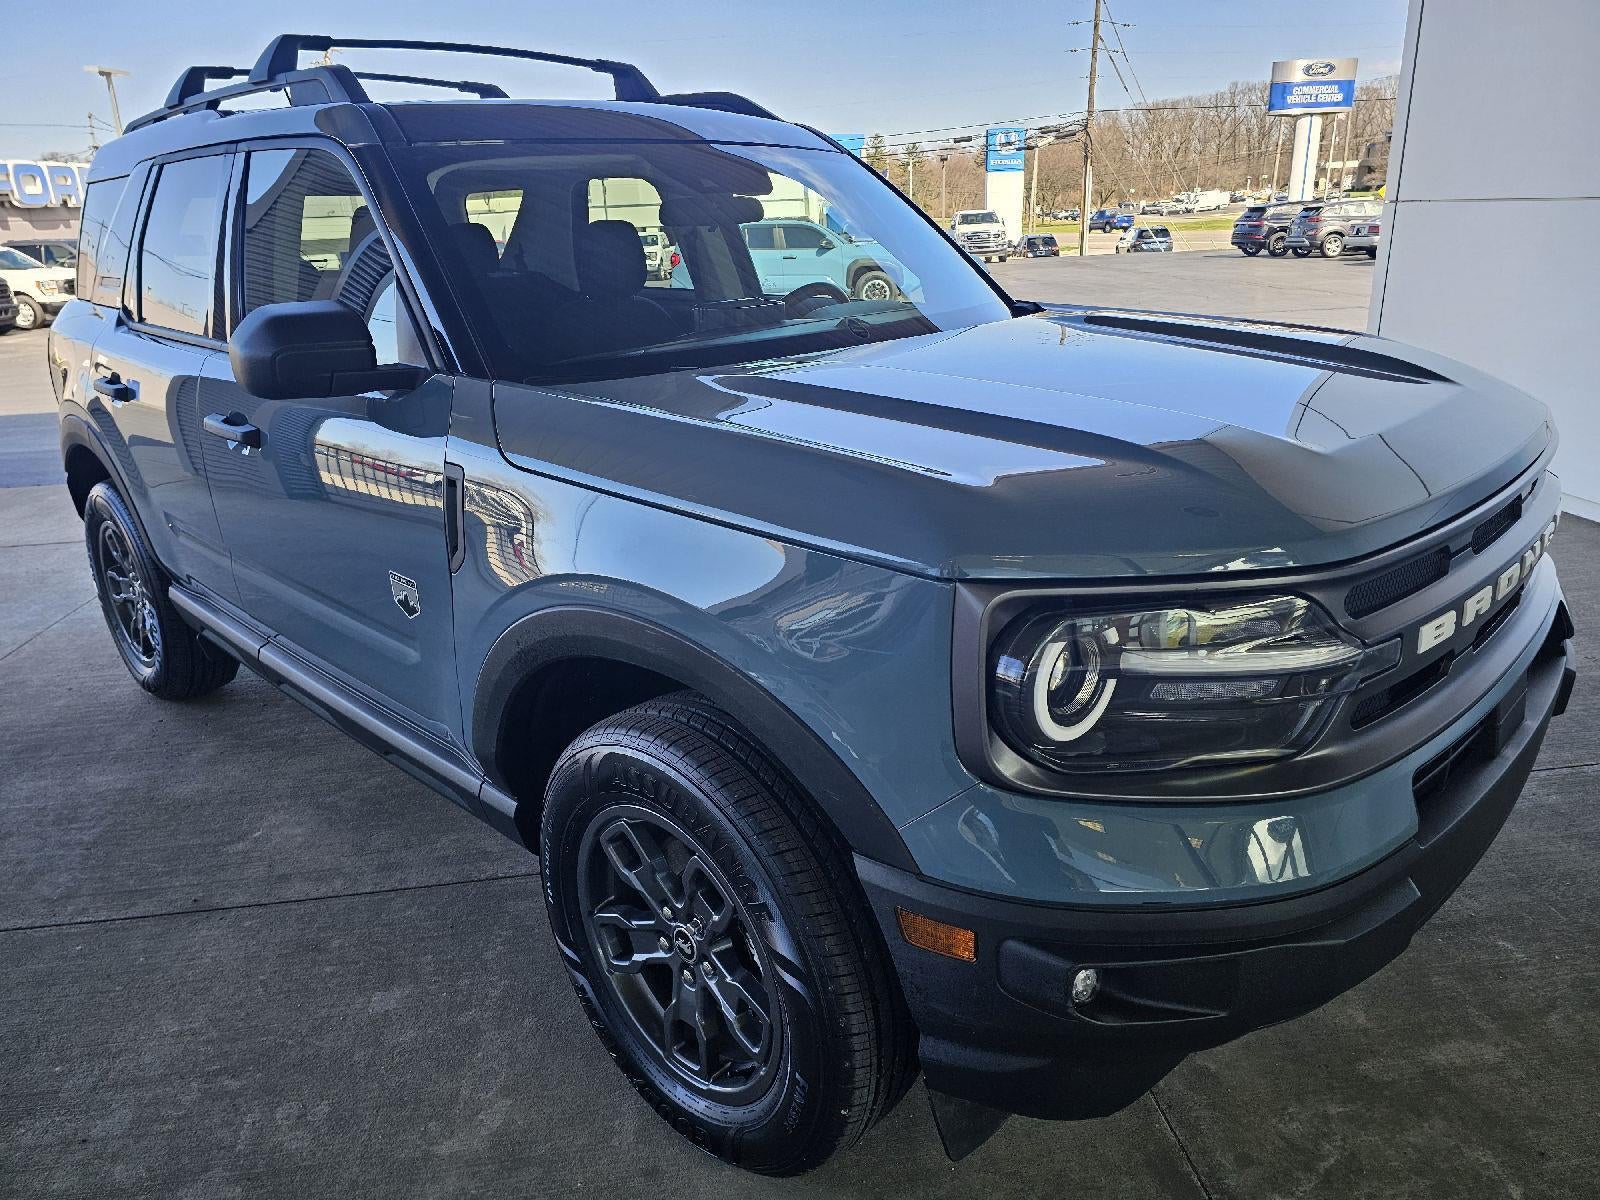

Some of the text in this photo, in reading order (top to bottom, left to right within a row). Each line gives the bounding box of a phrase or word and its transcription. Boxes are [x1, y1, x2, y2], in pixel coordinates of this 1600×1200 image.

[1293, 85, 1339, 95] COMMERCIAL
[1287, 93, 1344, 104] VEHICLE CENTER
